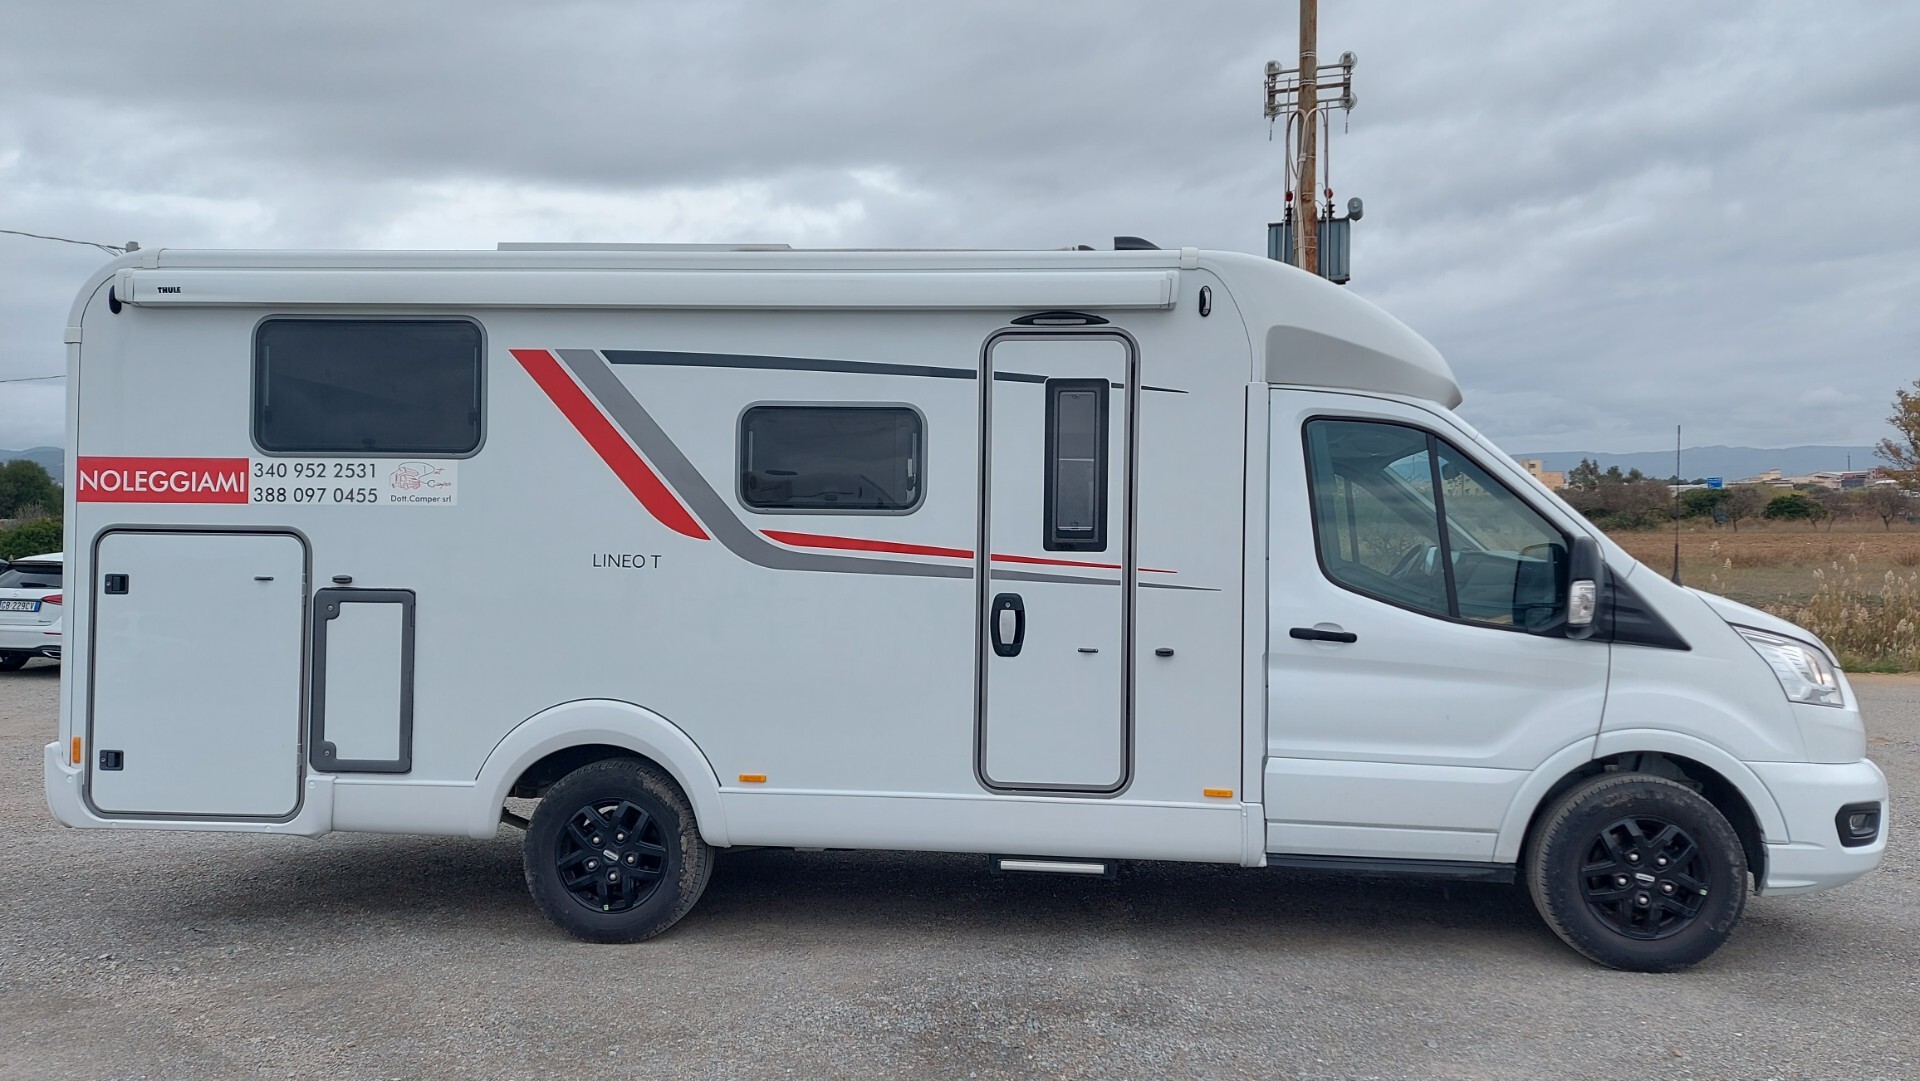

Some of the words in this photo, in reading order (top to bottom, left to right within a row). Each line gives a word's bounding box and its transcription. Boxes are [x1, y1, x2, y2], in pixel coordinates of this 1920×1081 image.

[157, 286, 182, 294] THULE
[253, 462, 287, 478] 340
[293, 462, 326, 479] 952
[333, 463, 375, 479] 2531
[79, 469, 245, 493] NOLEGGIAMI
[253, 487, 287, 502] 388
[293, 487, 327, 503] 097
[333, 487, 378, 503] 0455
[390, 494, 440, 504] Dott.Camper
[442, 495, 452, 503] srl
[593, 553, 646, 569] LINEO
[650, 554, 662, 569] T
